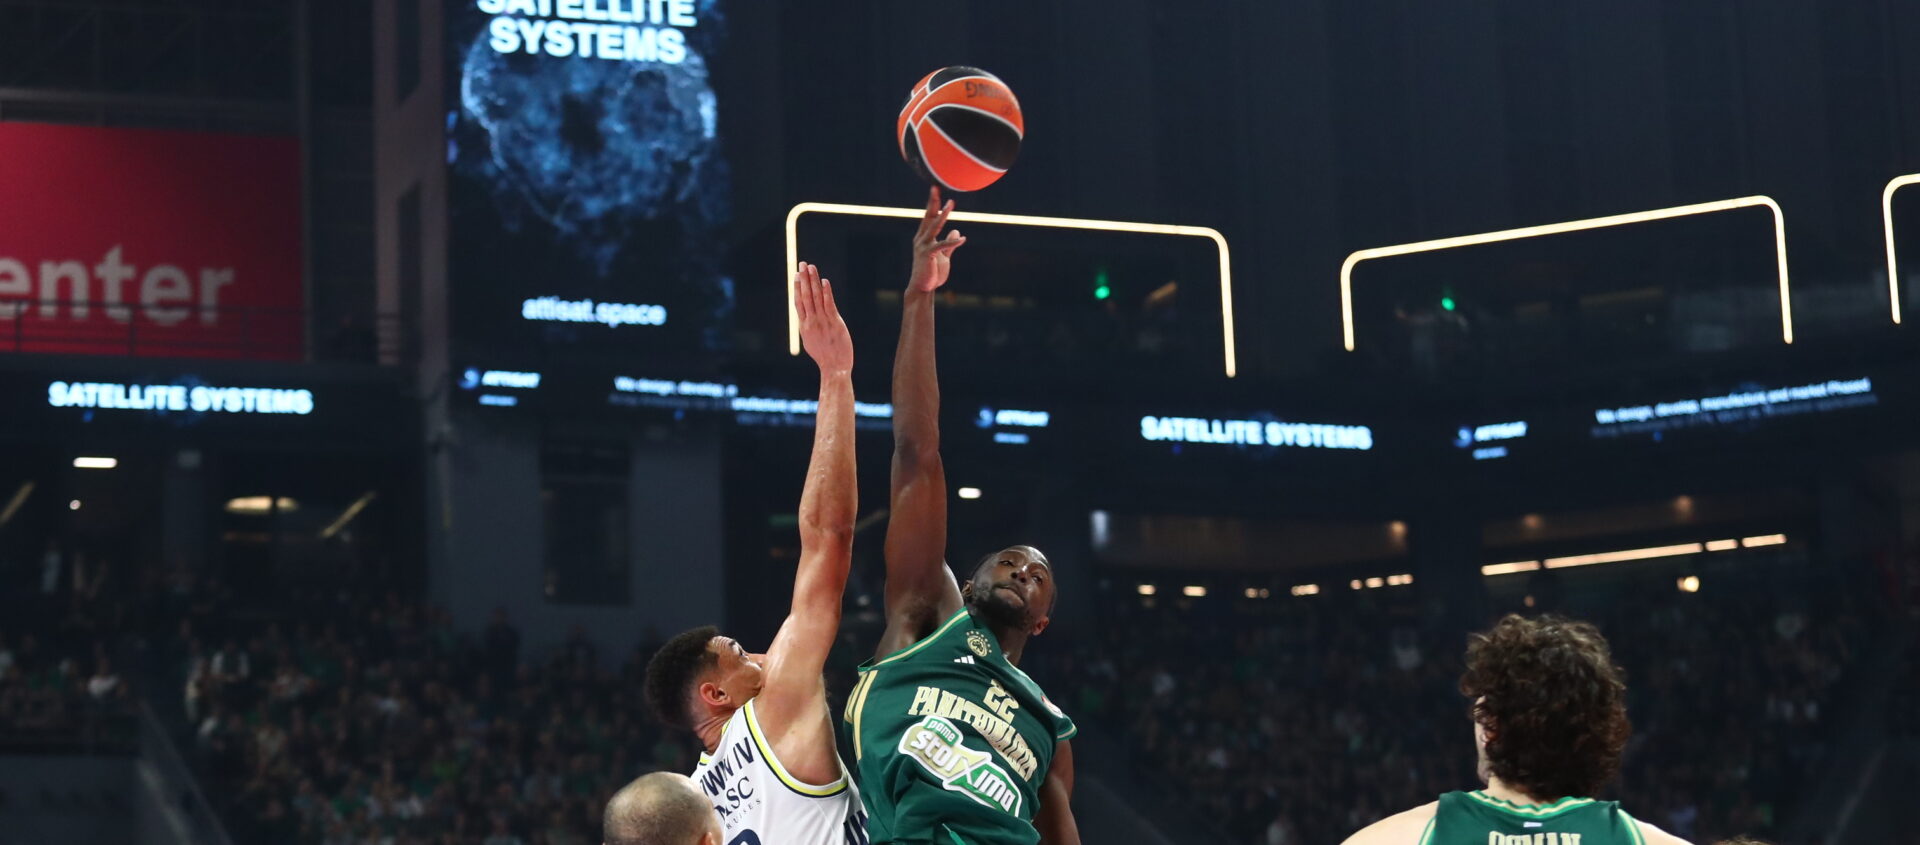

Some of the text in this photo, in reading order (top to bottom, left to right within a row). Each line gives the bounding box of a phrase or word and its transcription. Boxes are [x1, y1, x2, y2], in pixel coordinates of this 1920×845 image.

[489, 16, 688, 65] SYSTEMS
[0, 246, 235, 326] enter
[522, 297, 667, 327] attisat.space
[48, 381, 313, 415] SATELLITE SYSTEMS
[1141, 415, 1373, 451] SATELLITE SYSTEMS
[983, 679, 1019, 724] 22
[926, 719, 956, 743] pame
[732, 737, 754, 770] IV
